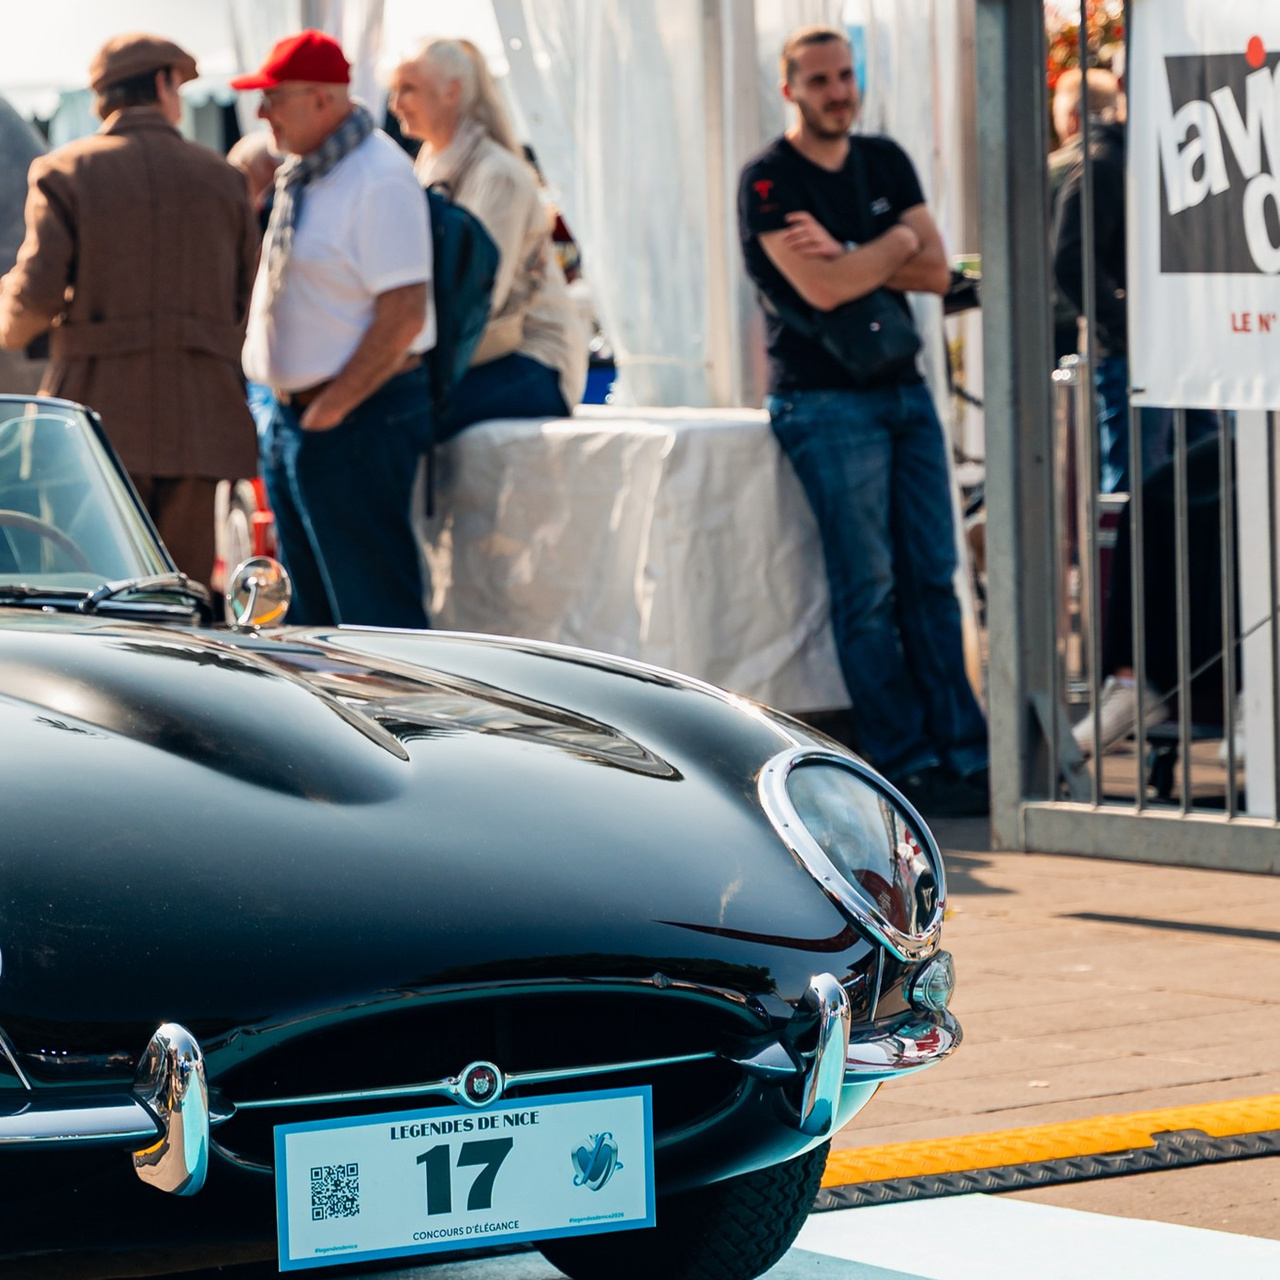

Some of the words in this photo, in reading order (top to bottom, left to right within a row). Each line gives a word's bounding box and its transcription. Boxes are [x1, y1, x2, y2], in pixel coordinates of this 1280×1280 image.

[1231, 312, 1251, 333] LE
[390, 1118, 474, 1141] LEGENDES
[478, 1115, 500, 1130] DE
[503, 1111, 540, 1127] NICE
[416, 1136, 514, 1216] 17
[412, 1226, 464, 1241] CONCOURS
[466, 1220, 520, 1235] D'ÉLÉGANCE
